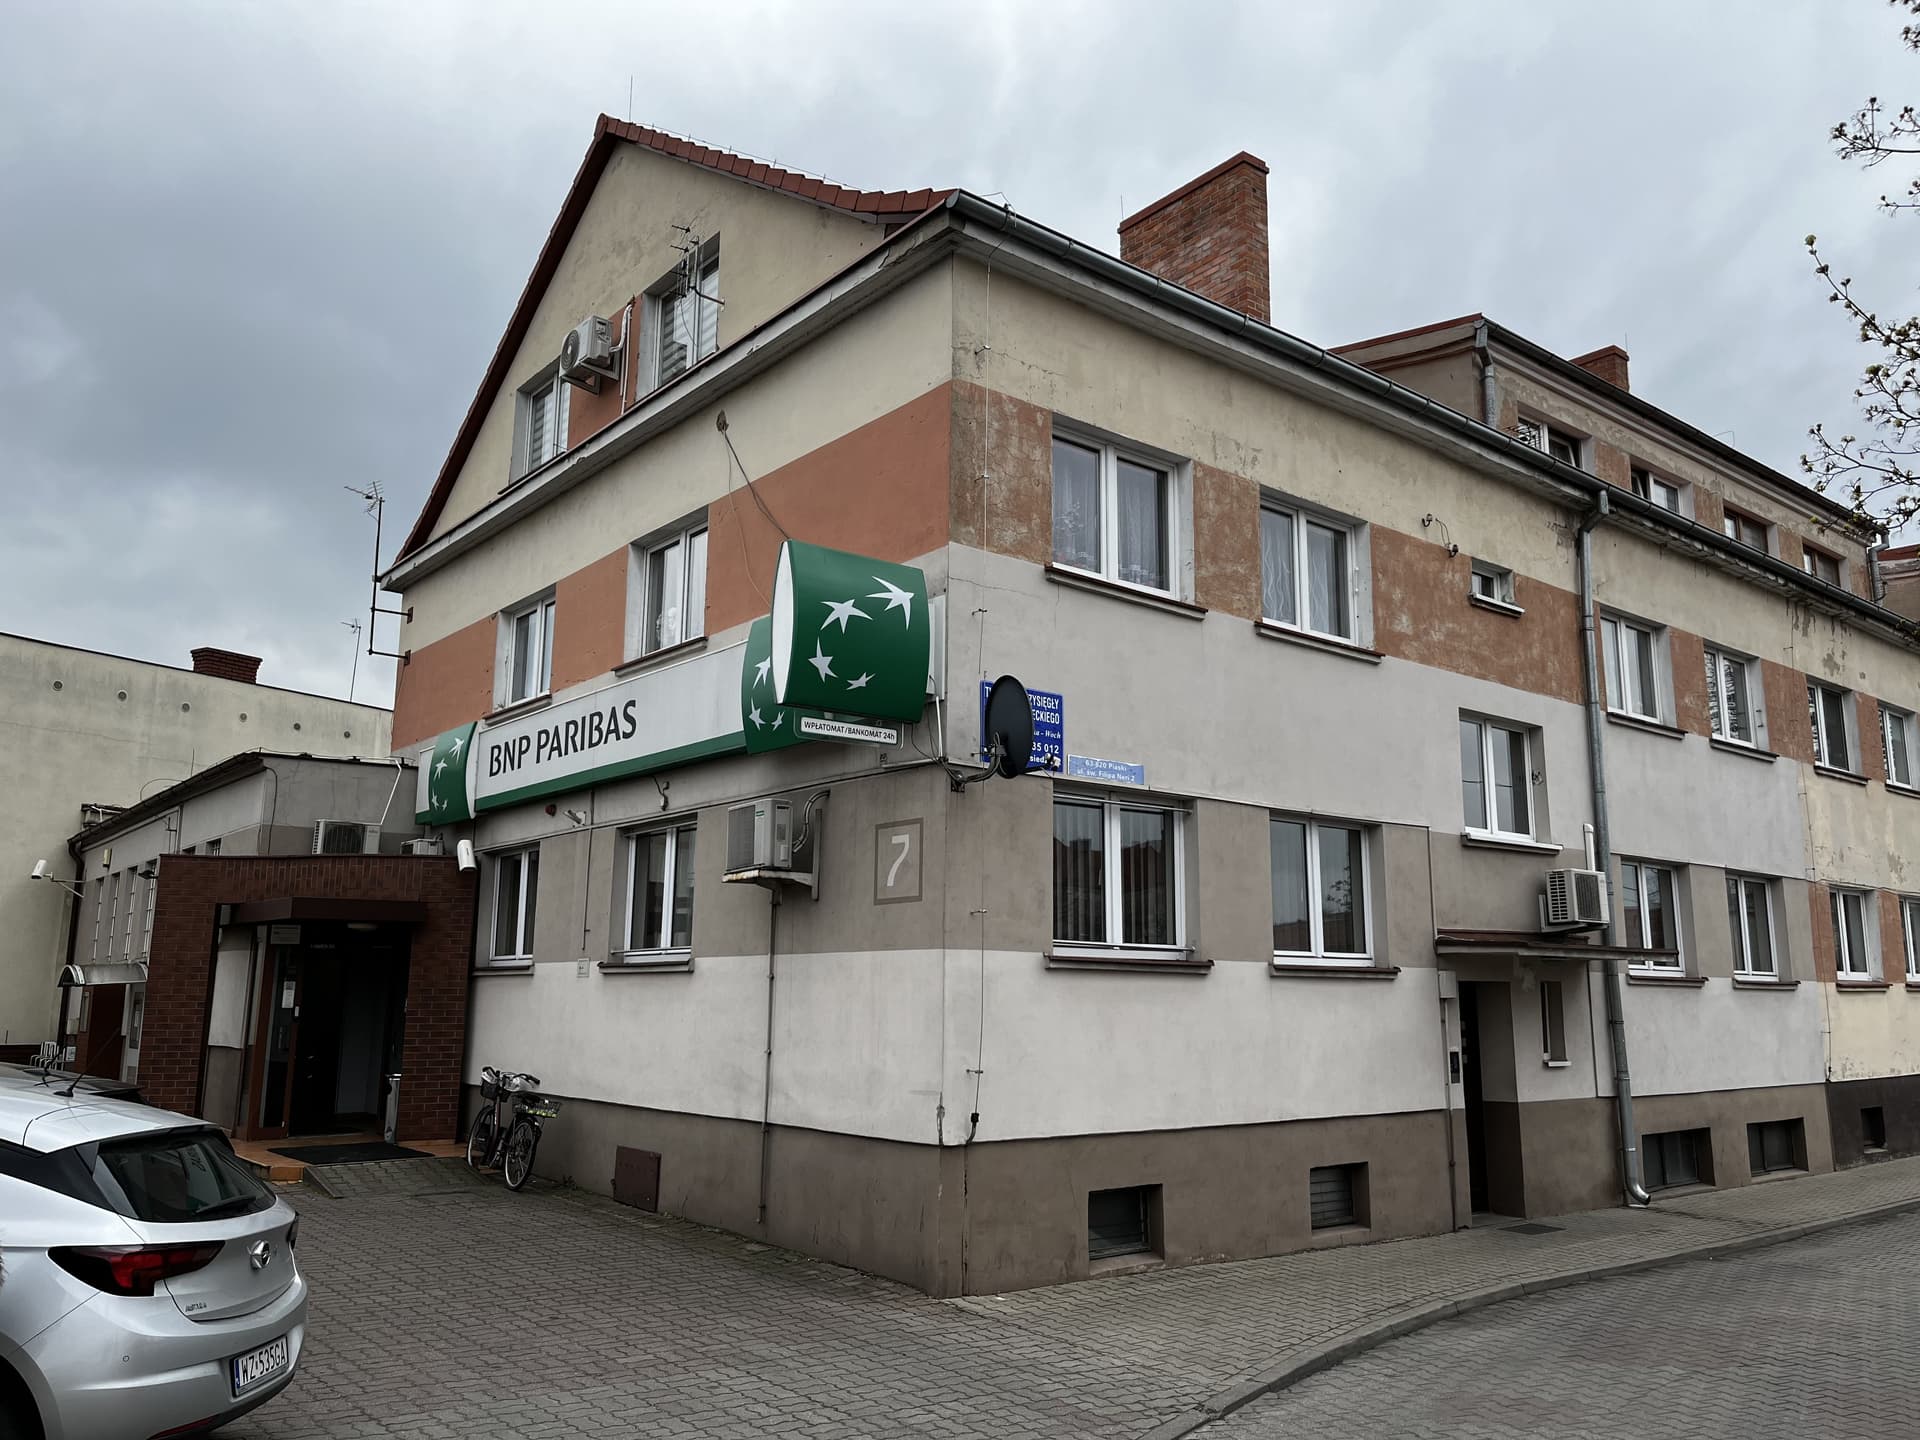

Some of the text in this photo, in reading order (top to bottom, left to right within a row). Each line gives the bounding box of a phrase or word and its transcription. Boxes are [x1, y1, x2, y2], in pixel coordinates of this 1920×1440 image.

[1029, 694, 1059, 710] ZYSIĘGŁY
[1032, 709, 1060, 725] ECKIEGO
[490, 700, 637, 777] BNP PARIBAS
[883, 732, 895, 740] 24h
[1044, 744, 1059, 754] 012
[1108, 763, 1127, 771] Piaski
[887, 834, 910, 886] 7
